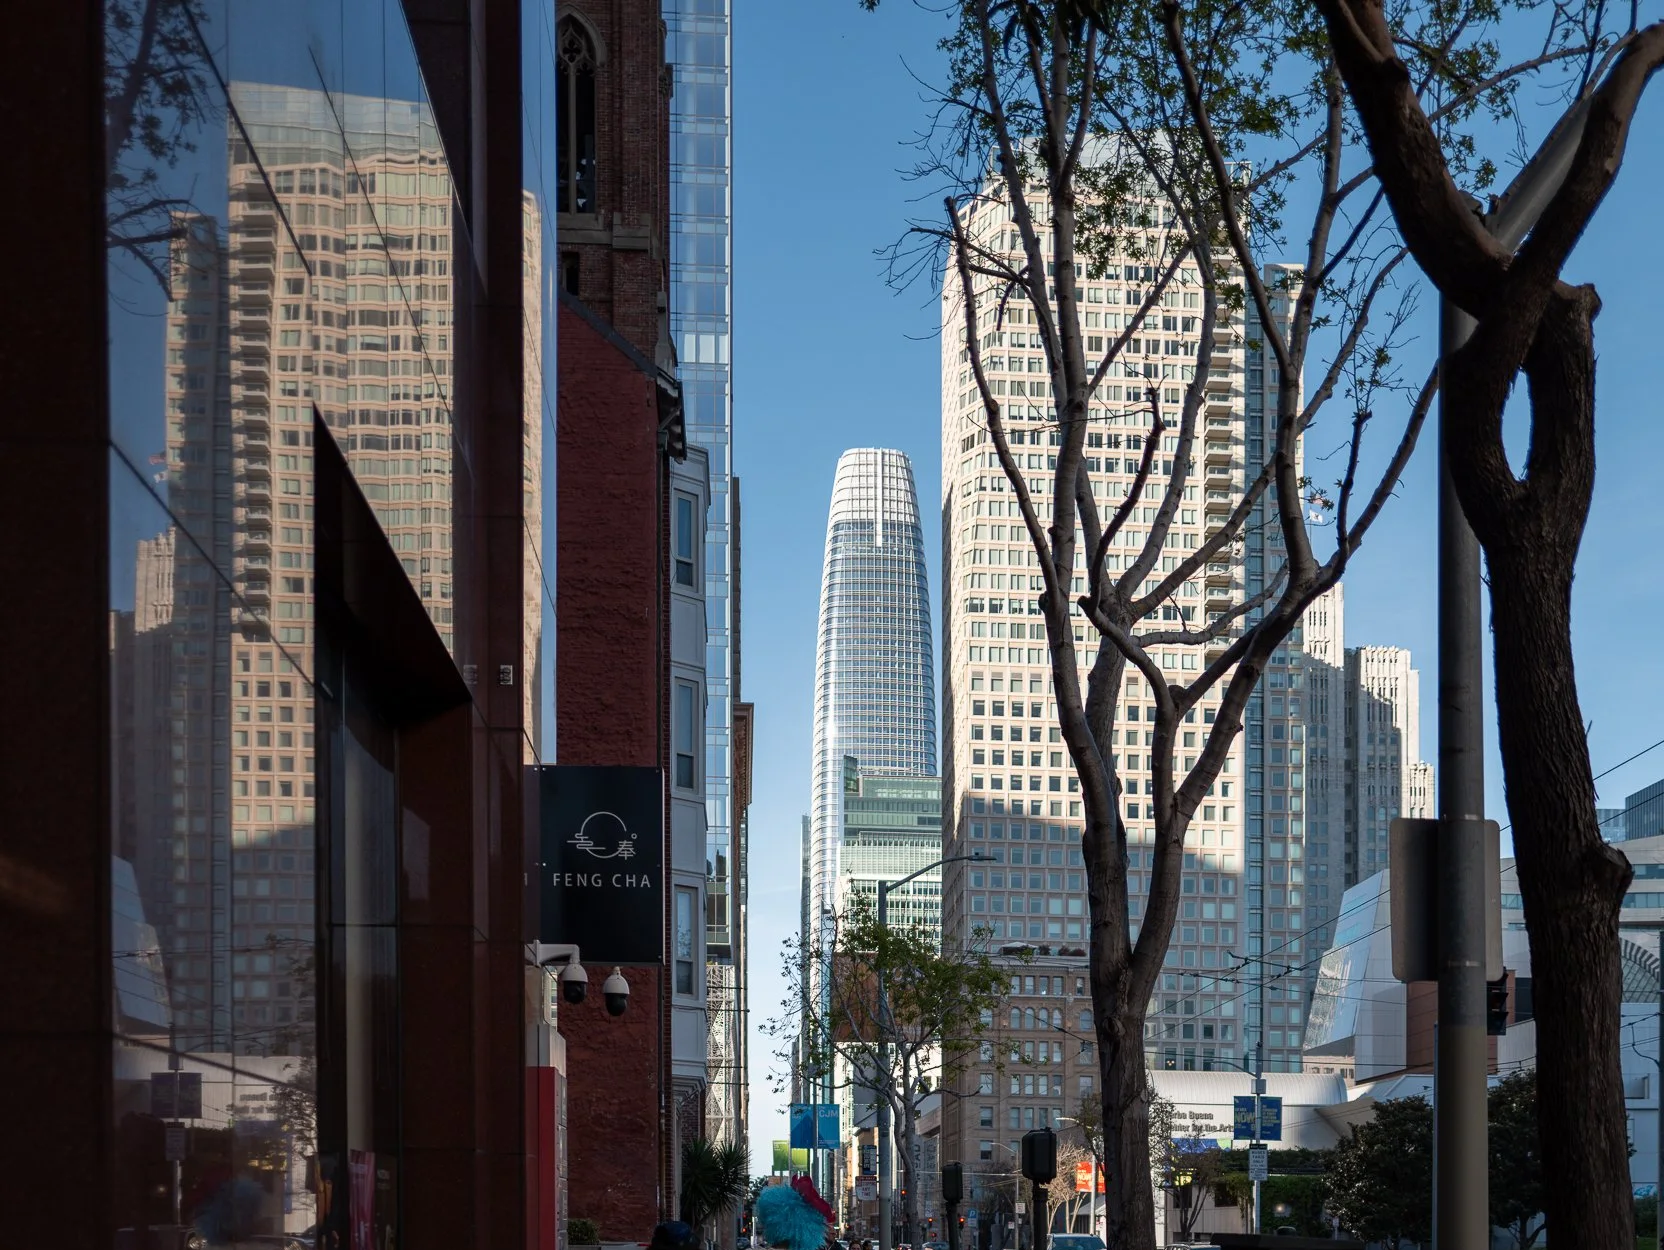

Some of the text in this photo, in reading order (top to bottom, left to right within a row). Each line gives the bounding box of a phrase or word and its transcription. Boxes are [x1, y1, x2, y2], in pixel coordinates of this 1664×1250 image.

[553, 873, 651, 888] FENG CHA
[819, 1109, 838, 1118] CJM
[1169, 1110, 1214, 1120] erba Buena
[1170, 1124, 1190, 1132] enter
[1204, 1123, 1217, 1132] the
